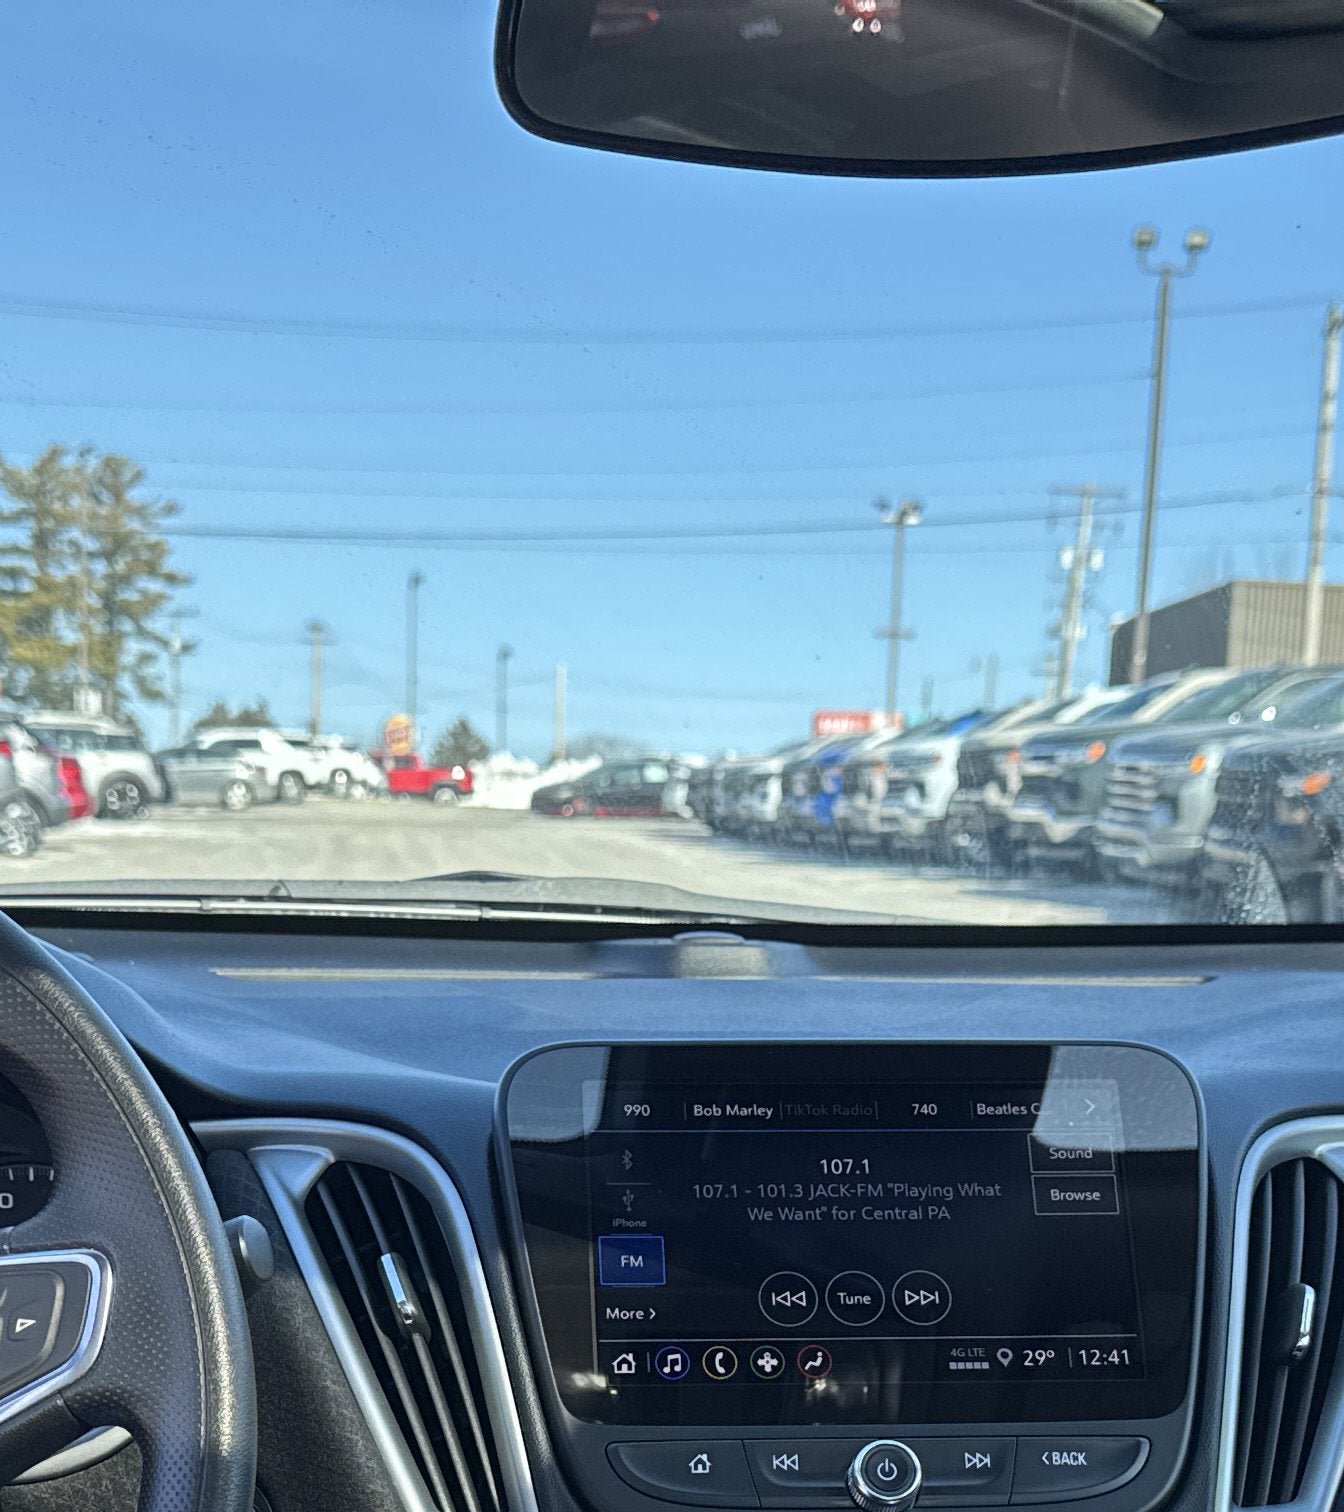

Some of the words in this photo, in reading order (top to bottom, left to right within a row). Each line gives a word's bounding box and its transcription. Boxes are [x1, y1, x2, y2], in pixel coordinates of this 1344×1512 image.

[623, 1104, 651, 1118] 990
[693, 1104, 722, 1117] Bob
[726, 1104, 774, 1120] Marley
[785, 1103, 828, 1117] TikTok
[833, 1103, 873, 1116] Radio
[911, 1103, 938, 1116] 740
[976, 1103, 1028, 1116] Beatles
[1049, 1147, 1093, 1160] Sound
[820, 1158, 871, 1175] 107.1
[693, 1184, 738, 1199] 107.1
[758, 1184, 804, 1198] 101.3
[808, 1183, 884, 1200] JACK-FM
[887, 1182, 954, 1200] "Playing
[957, 1182, 1002, 1197] What
[1050, 1189, 1101, 1201] Browse
[747, 1206, 774, 1221] We
[778, 1205, 828, 1221] Want"
[831, 1205, 856, 1220] for
[861, 1205, 923, 1220] Central
[928, 1206, 951, 1220] PA
[612, 1217, 648, 1229] iPhone
[620, 1255, 644, 1268] FM
[837, 1292, 872, 1305] Tune
[606, 1307, 645, 1320] More
[950, 1347, 966, 1357] 4G
[967, 1347, 986, 1357] LTE
[1079, 1348, 1130, 1366] 12:41
[1052, 1451, 1087, 1467] BACK
